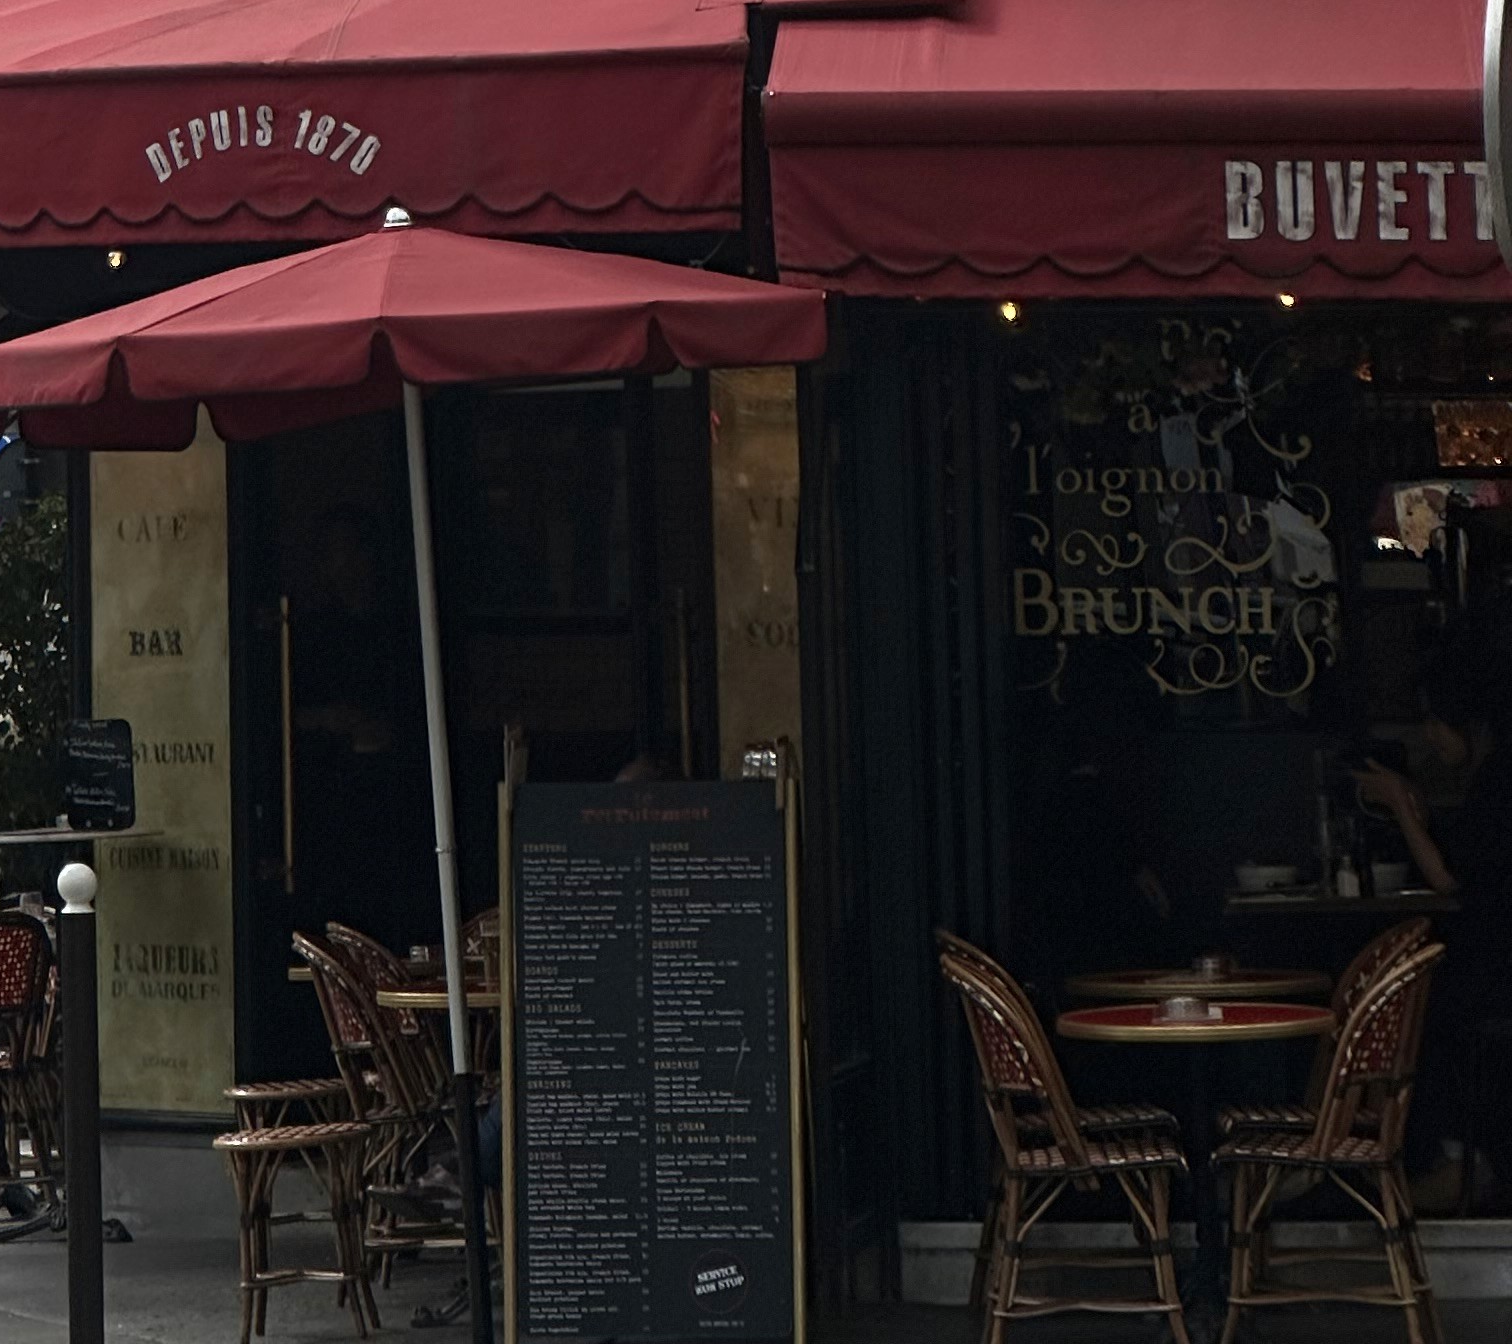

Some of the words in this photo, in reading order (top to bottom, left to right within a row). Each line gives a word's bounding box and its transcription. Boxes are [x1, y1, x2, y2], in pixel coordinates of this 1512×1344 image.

[144, 105, 275, 184] DEPUIS
[293, 109, 382, 176] 1870
[1224, 160, 1495, 242] BUVETT
[128, 629, 183, 657] BAR
[133, 742, 215, 764] STAURANT
